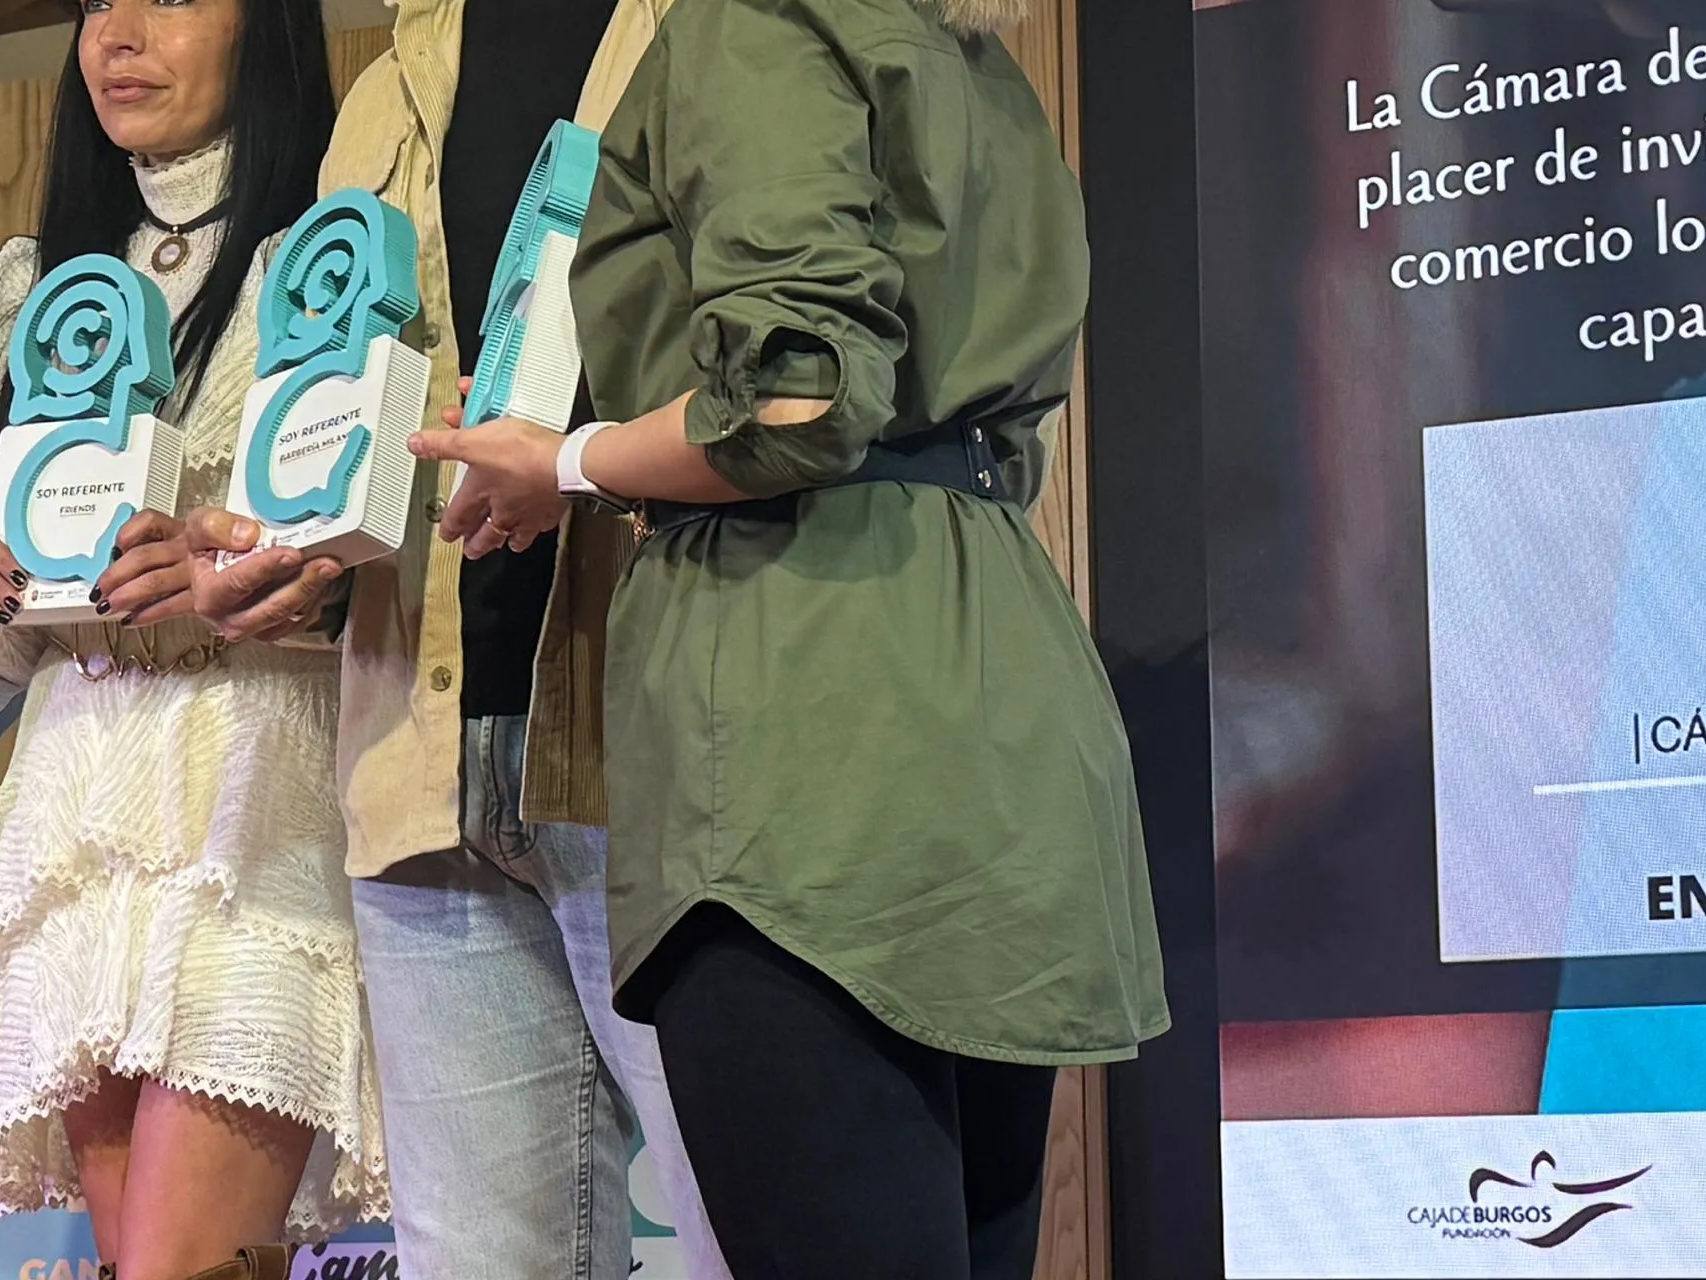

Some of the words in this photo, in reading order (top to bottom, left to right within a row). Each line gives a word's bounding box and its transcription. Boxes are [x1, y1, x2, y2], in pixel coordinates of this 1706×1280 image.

[1348, 81, 1401, 131] La
[1421, 60, 1626, 119] Cámara
[1359, 151, 1514, 228] placer
[1535, 128, 1597, 185] de
[1392, 218, 1632, 288] comercio
[279, 431, 299, 446] SOY
[301, 407, 361, 437] REFERENTE
[36, 488, 58, 499] SOY
[62, 482, 125, 496] REFERENTE
